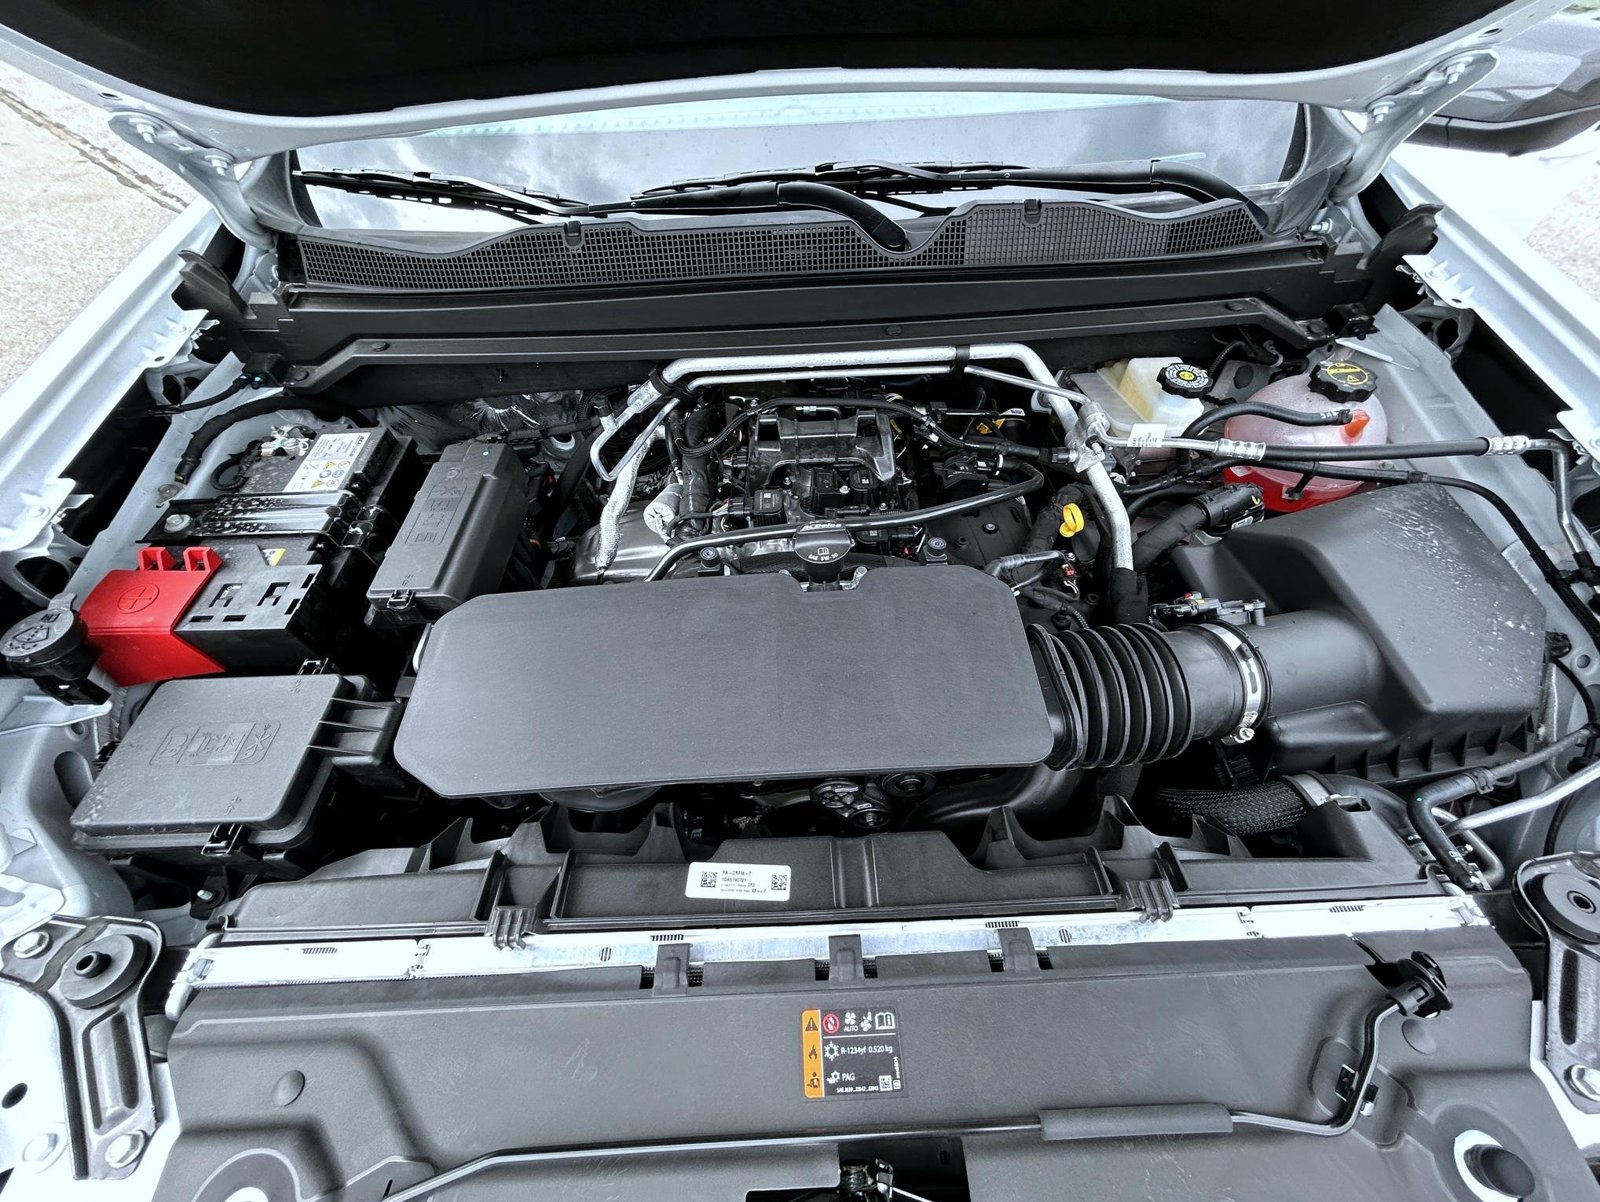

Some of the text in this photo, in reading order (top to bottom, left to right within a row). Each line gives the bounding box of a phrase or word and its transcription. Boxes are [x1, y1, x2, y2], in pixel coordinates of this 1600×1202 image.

[841, 1045, 893, 1055] R-1234yf 0.520 kg
[842, 1072, 855, 1081] PAG
